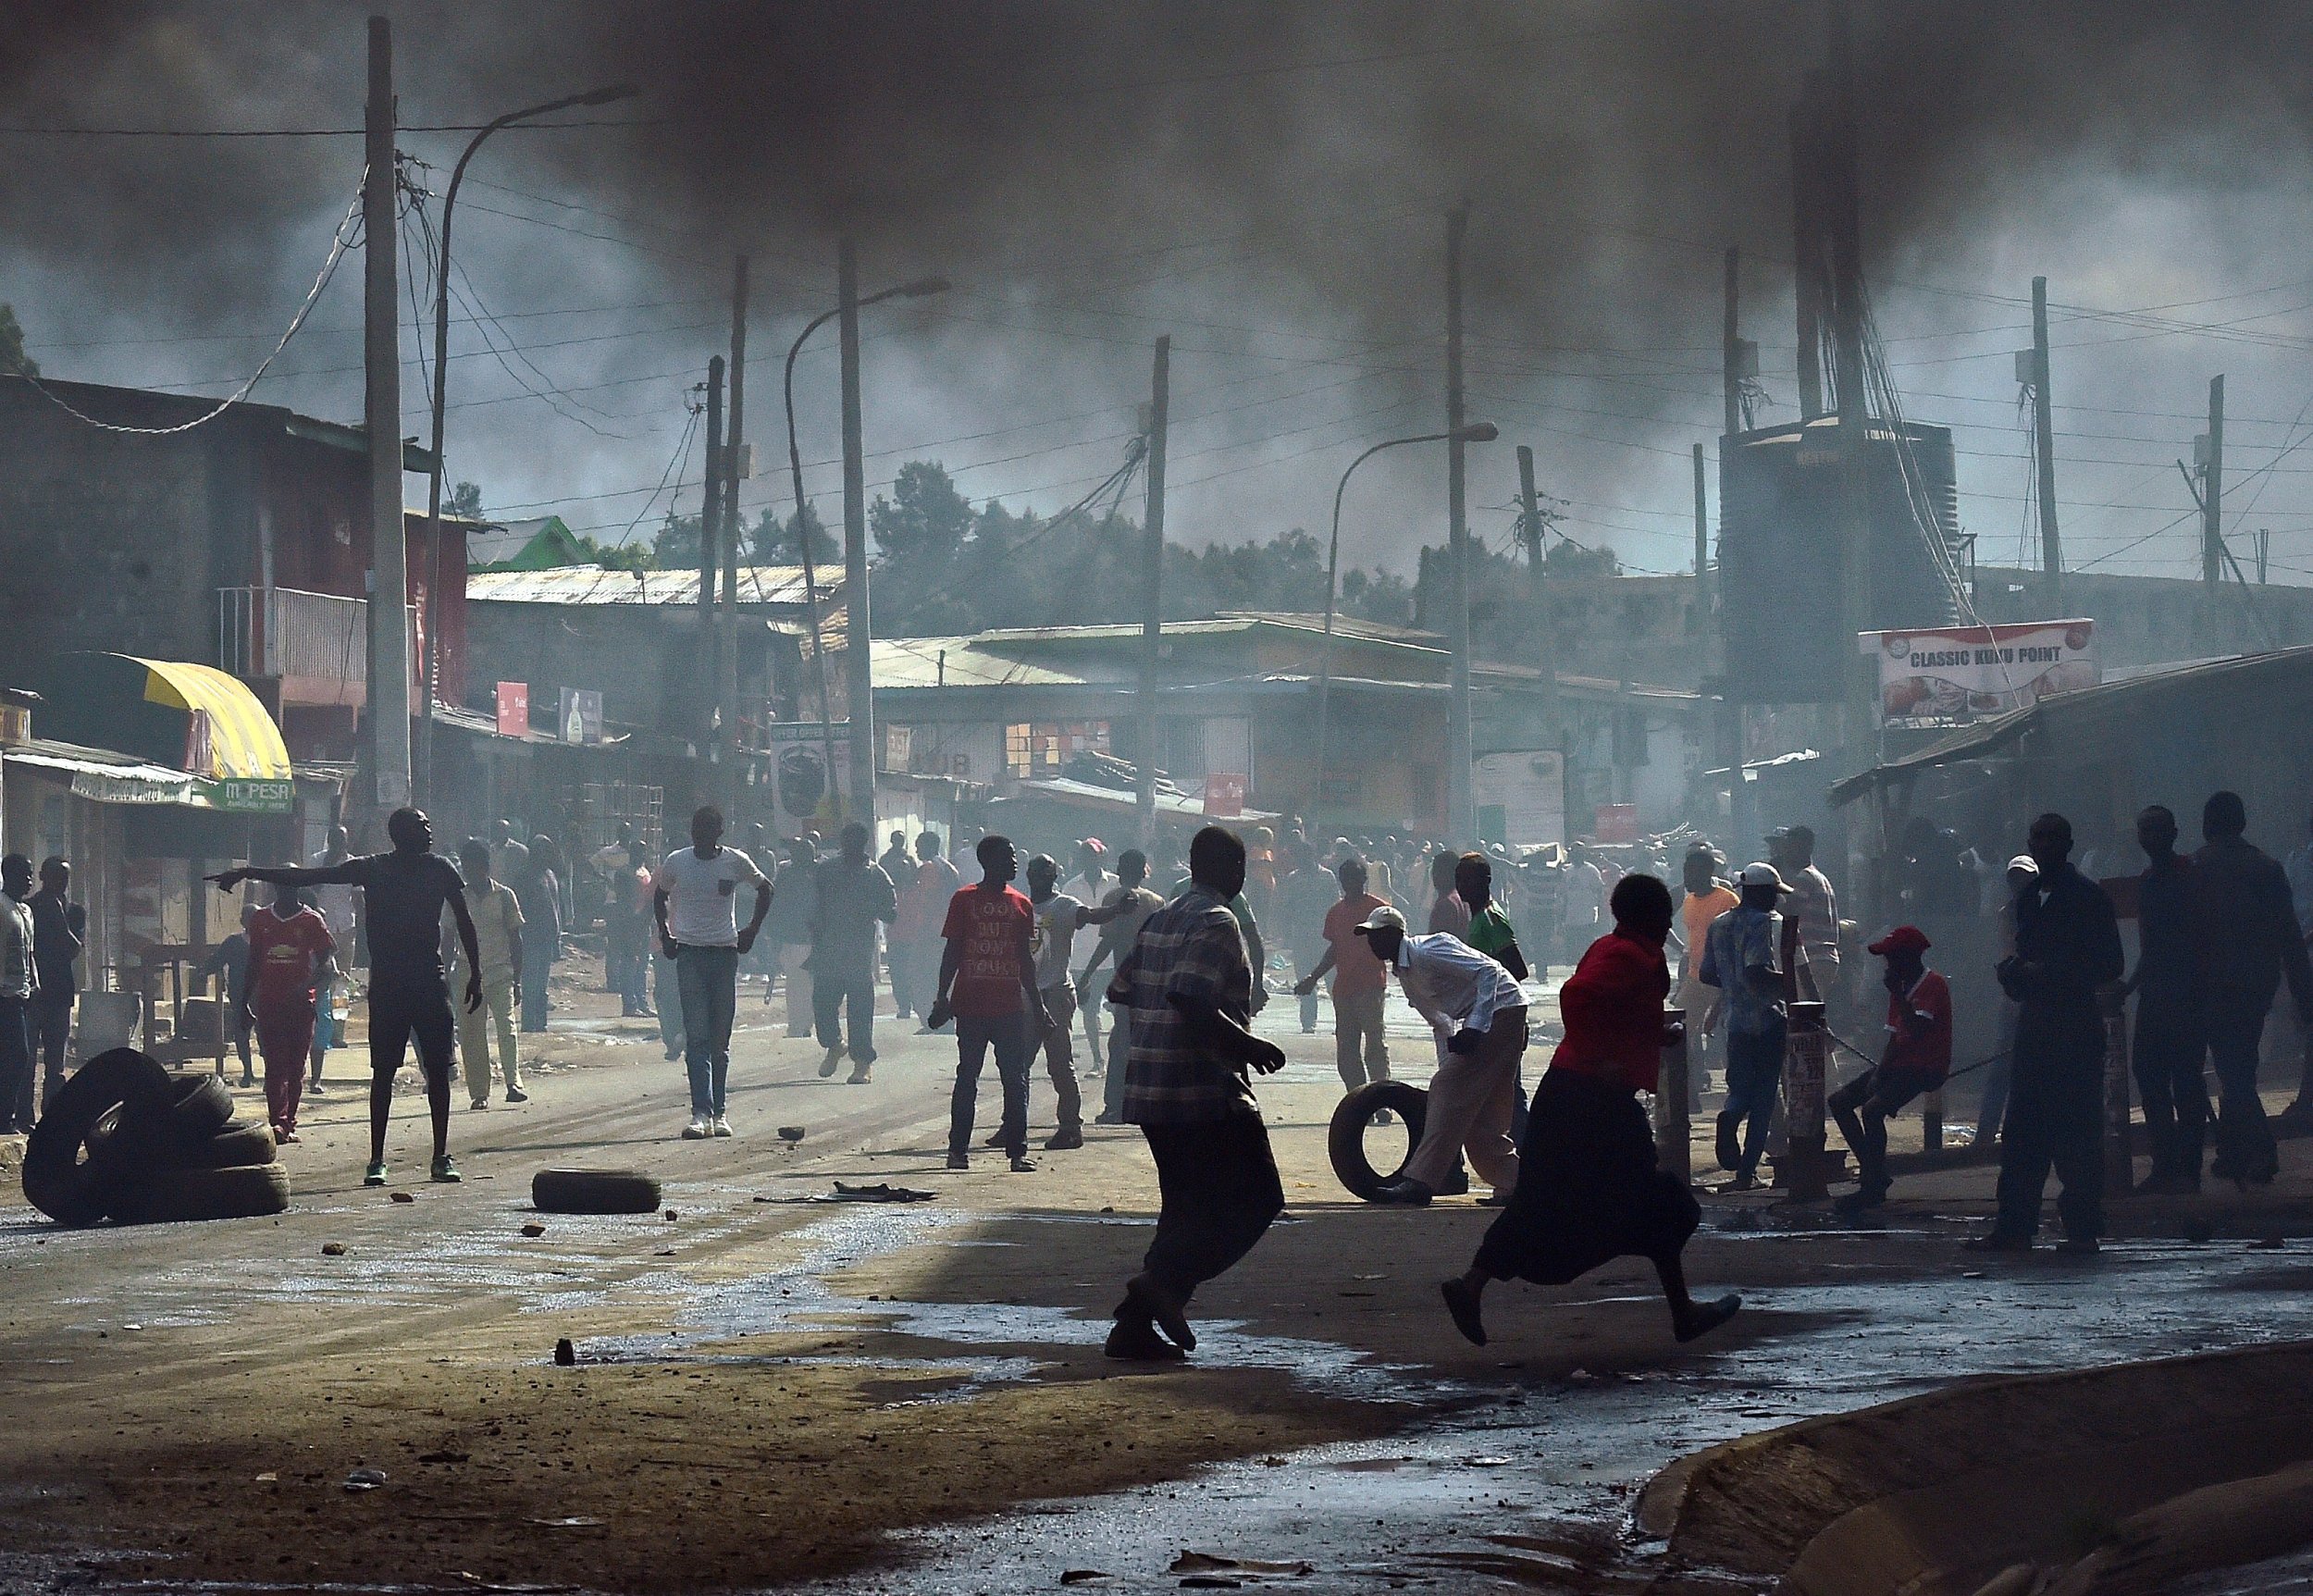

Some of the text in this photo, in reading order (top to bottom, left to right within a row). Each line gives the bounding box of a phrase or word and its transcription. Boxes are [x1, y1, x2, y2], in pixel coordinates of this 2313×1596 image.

[1910, 647, 2061, 668] CLASSIC KUKU POINT
[250, 784, 289, 799] PESA
